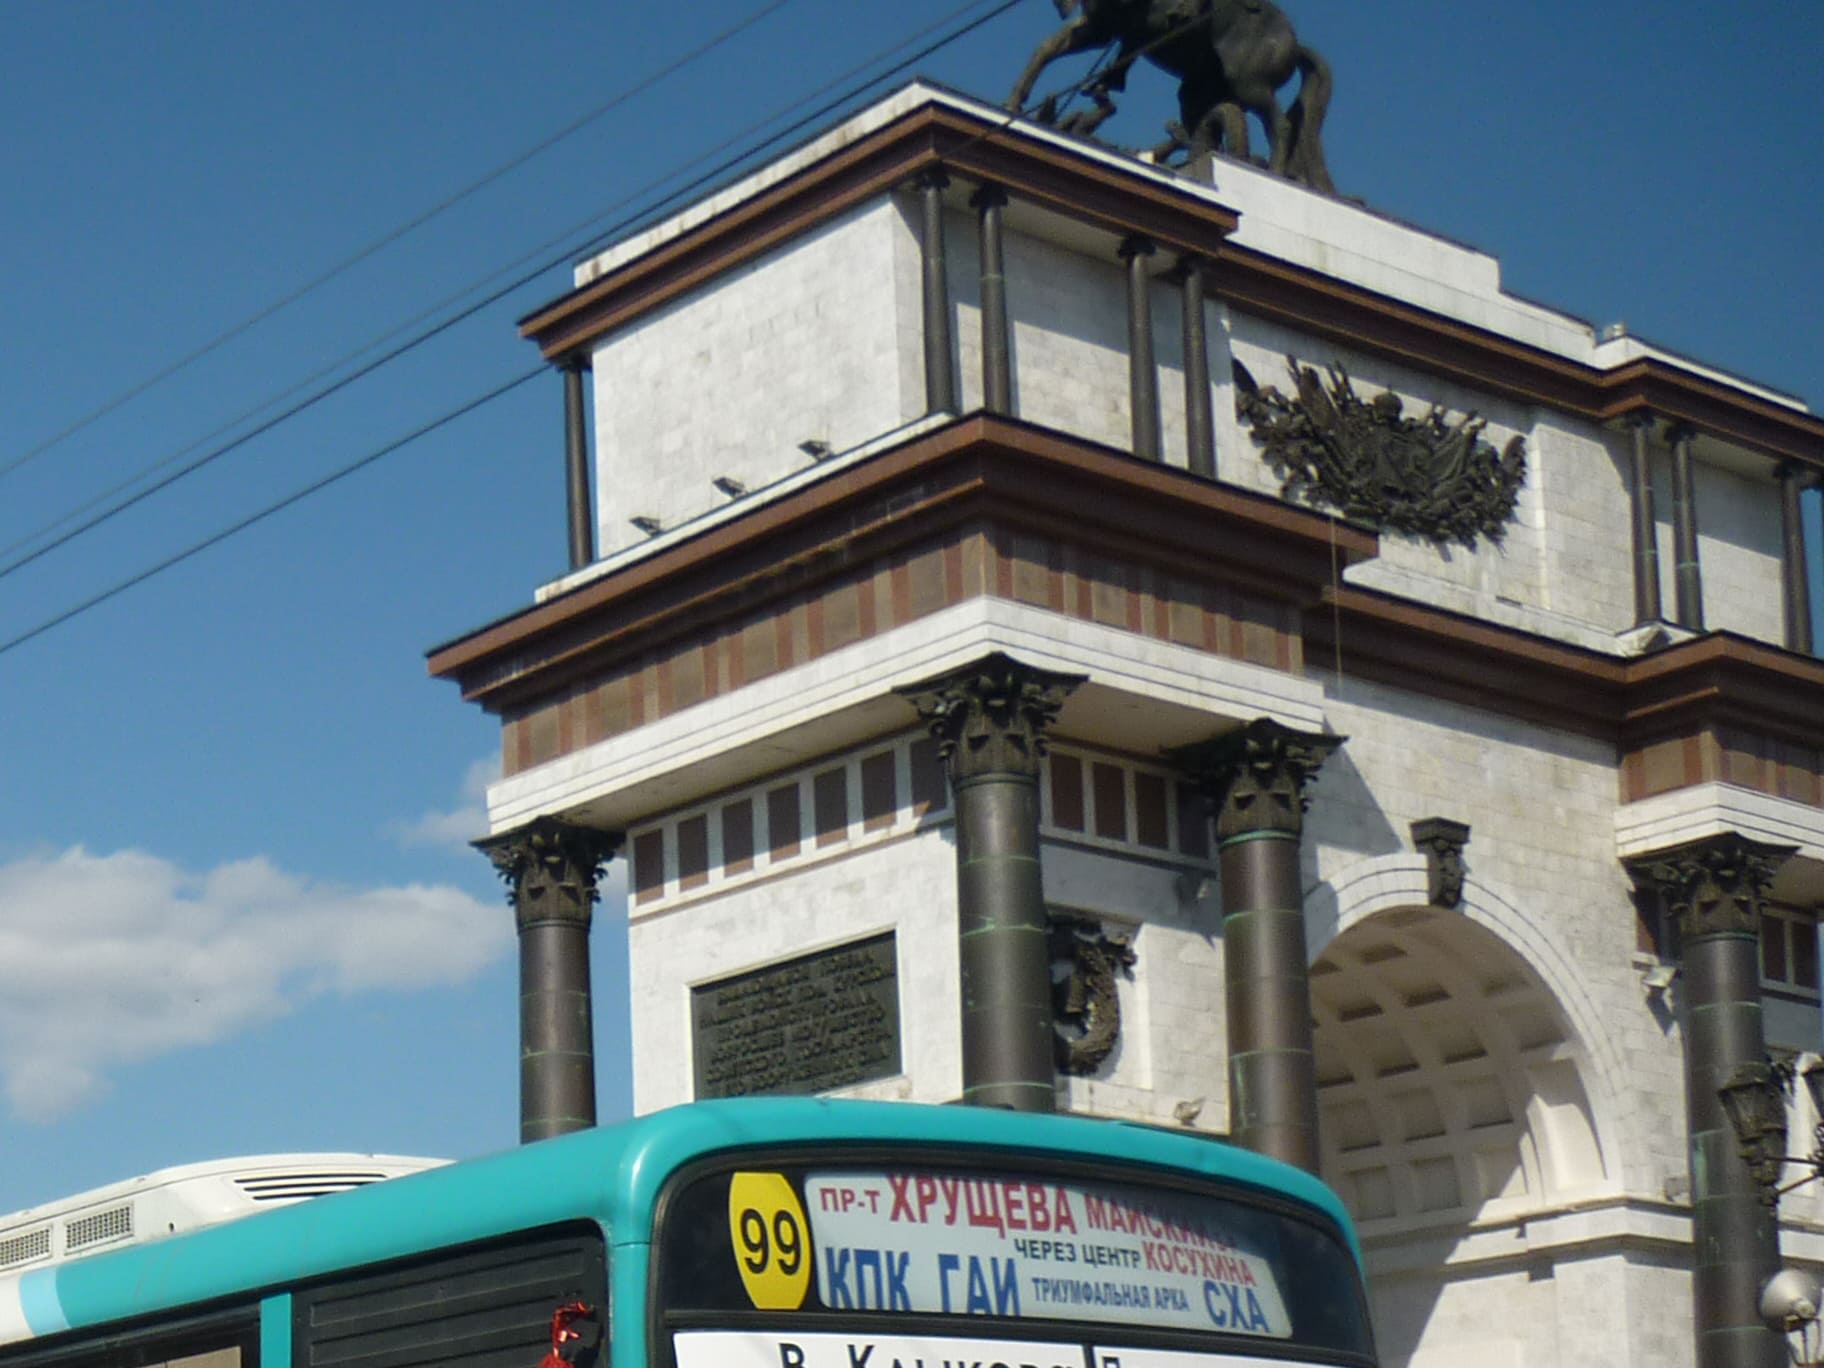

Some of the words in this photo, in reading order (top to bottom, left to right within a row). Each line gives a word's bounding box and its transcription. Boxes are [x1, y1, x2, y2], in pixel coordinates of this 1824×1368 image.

[819, 1187, 880, 1214] ПР-Т
[886, 1174, 1078, 1239] ХРУЩЕВА
[741, 1208, 802, 1276] 99
[1014, 1238, 1076, 1262] ЧЕРЕЗ
[1081, 1244, 1141, 1268] ЦЕНТР
[1142, 1241, 1257, 1287] КОСУХИНА
[825, 1246, 913, 1312] КПК
[938, 1253, 1022, 1317] ГАИ
[1032, 1277, 1151, 1309] ТРИУМФАЛЬНАЯ
[1155, 1287, 1191, 1313] АРКА
[1203, 1279, 1272, 1334] СХА
